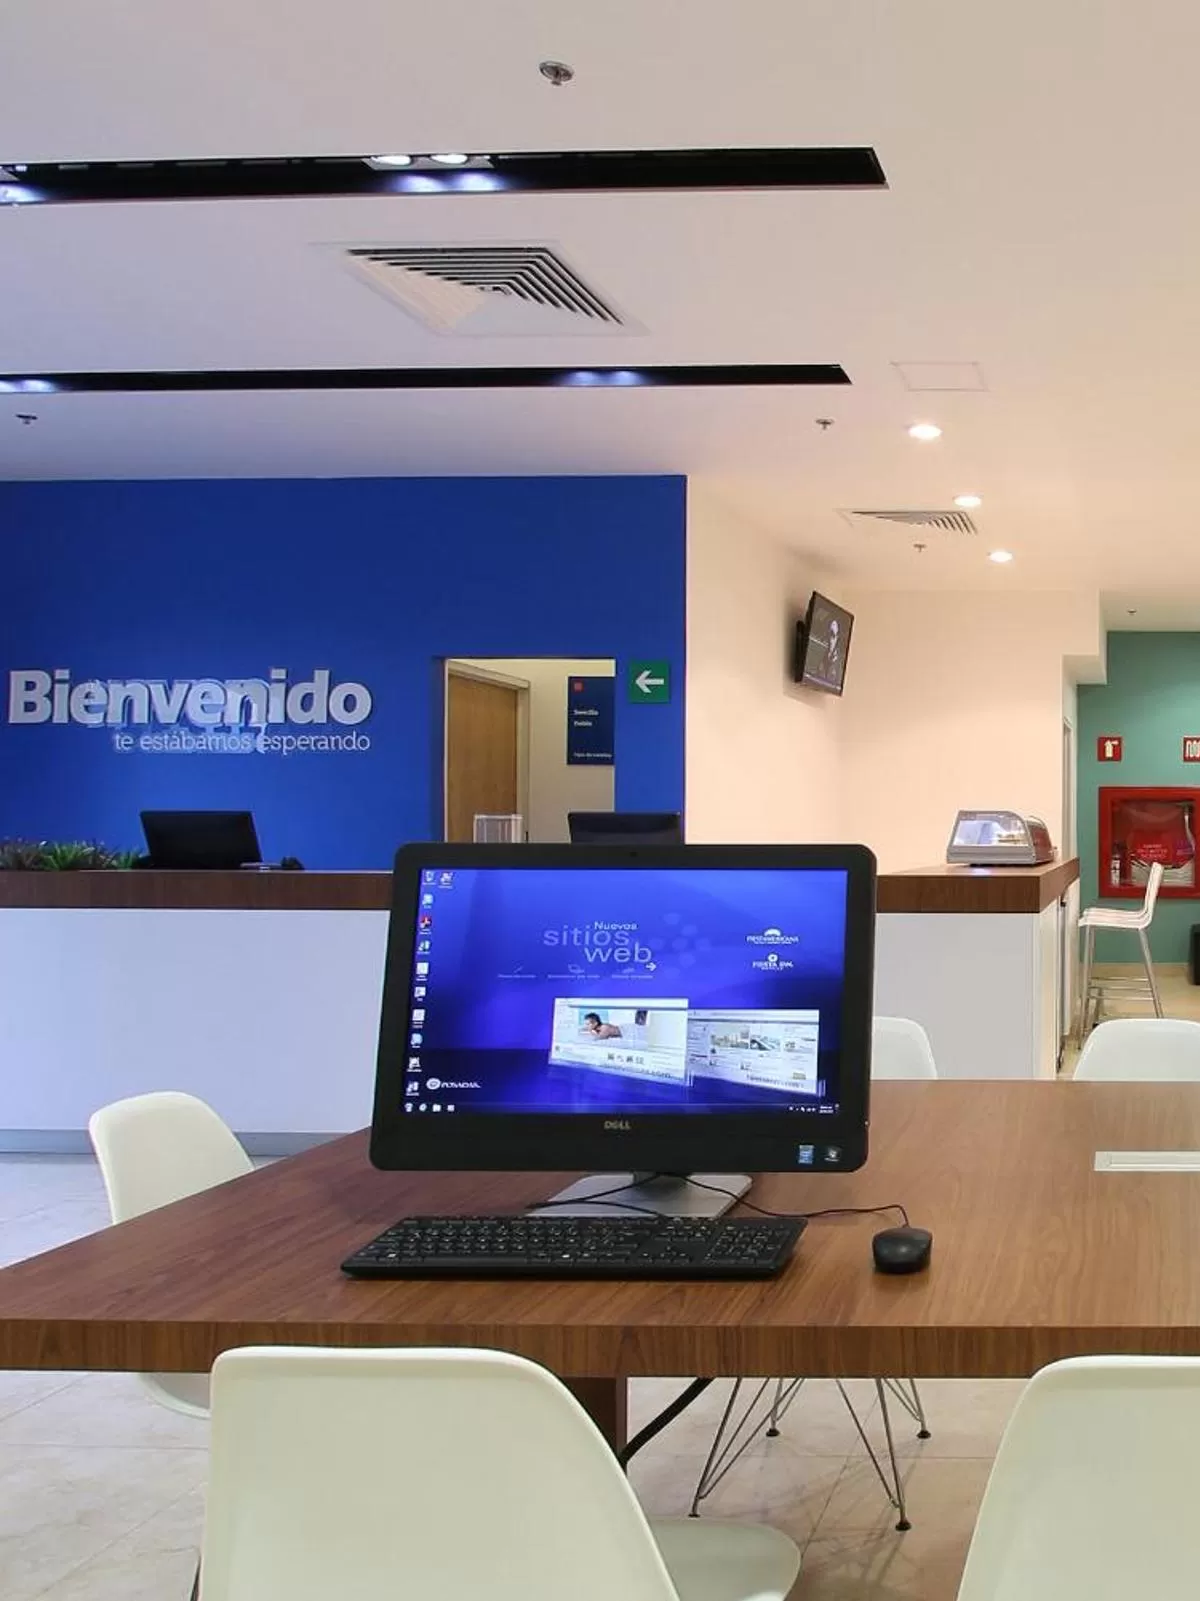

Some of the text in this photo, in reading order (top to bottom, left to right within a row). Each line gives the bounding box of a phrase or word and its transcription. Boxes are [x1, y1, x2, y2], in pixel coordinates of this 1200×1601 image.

[9, 668, 372, 725] Bienvenido
[114, 730, 135, 751] te
[261, 730, 371, 756] esperando
[543, 924, 630, 946] sitios
[584, 941, 652, 963] web
[604, 1119, 631, 1130] DELL
